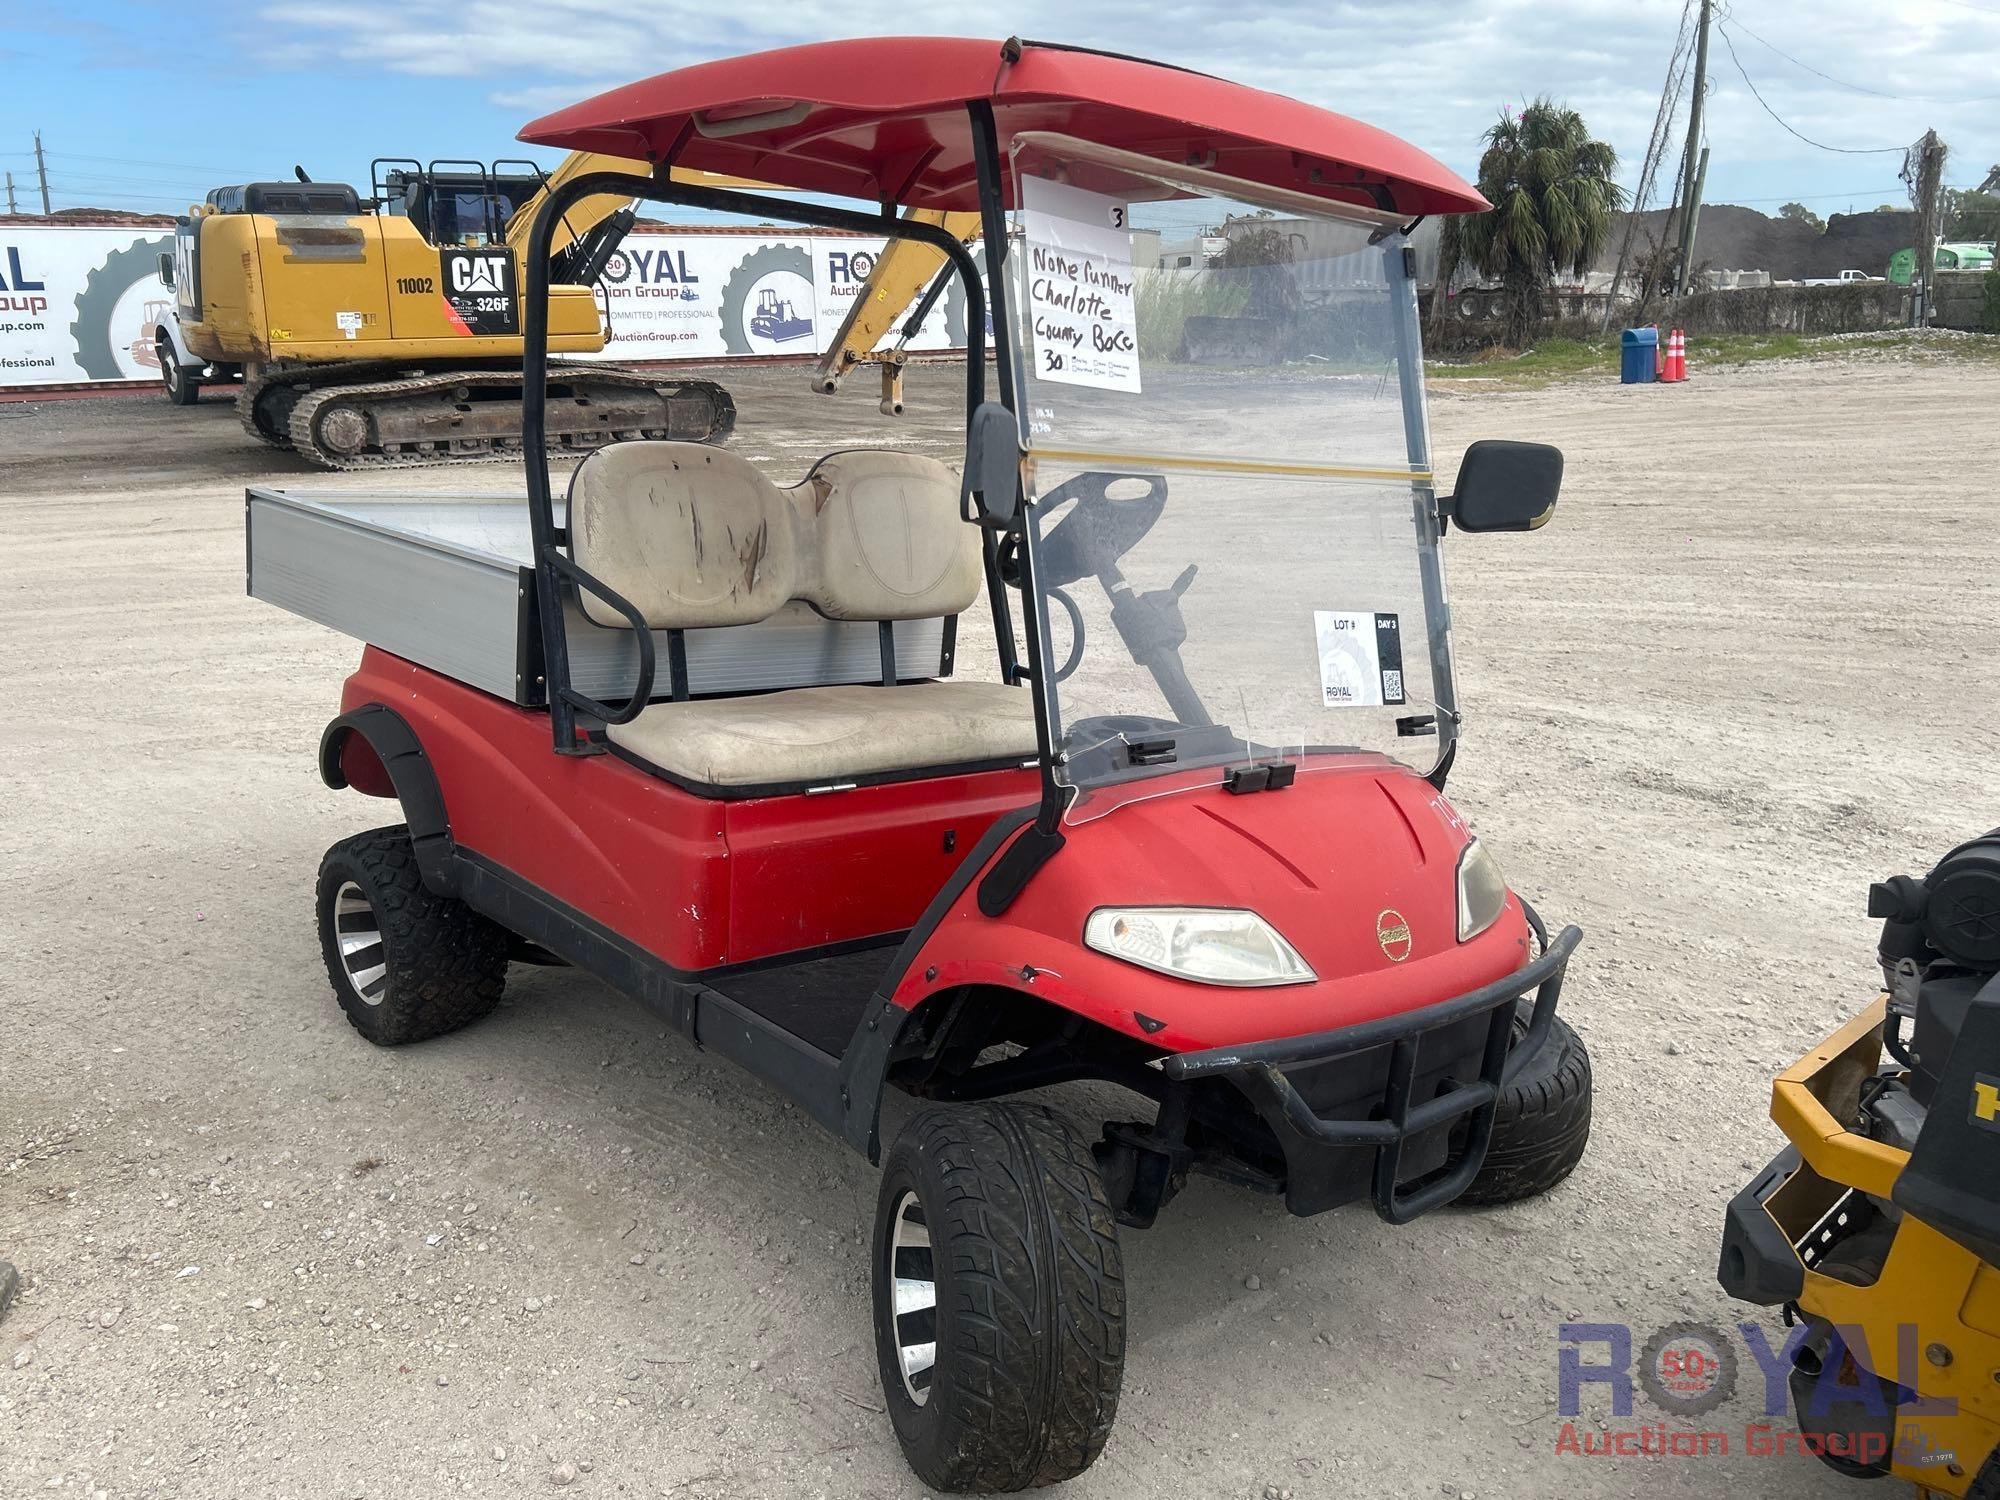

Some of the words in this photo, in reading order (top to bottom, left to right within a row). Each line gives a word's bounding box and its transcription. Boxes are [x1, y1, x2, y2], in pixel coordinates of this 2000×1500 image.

[1112, 208, 1124, 228] 3
[451, 256, 506, 292] CAT
[396, 278, 434, 294] 11002
[635, 285, 679, 300] Group
[477, 297, 509, 312] 326F
[1032, 278, 1113, 321] Charlotte
[503, 313, 510, 324] L
[658, 310, 715, 320] PROFESSIONAL
[1035, 316, 1083, 349] County
[0, 356, 55, 368] fessional
[1334, 619, 1349, 630] LOT
[1377, 619, 1391, 630] DAY
[1391, 620, 1397, 630] 3
[1326, 686, 1352, 697] ROYAL
